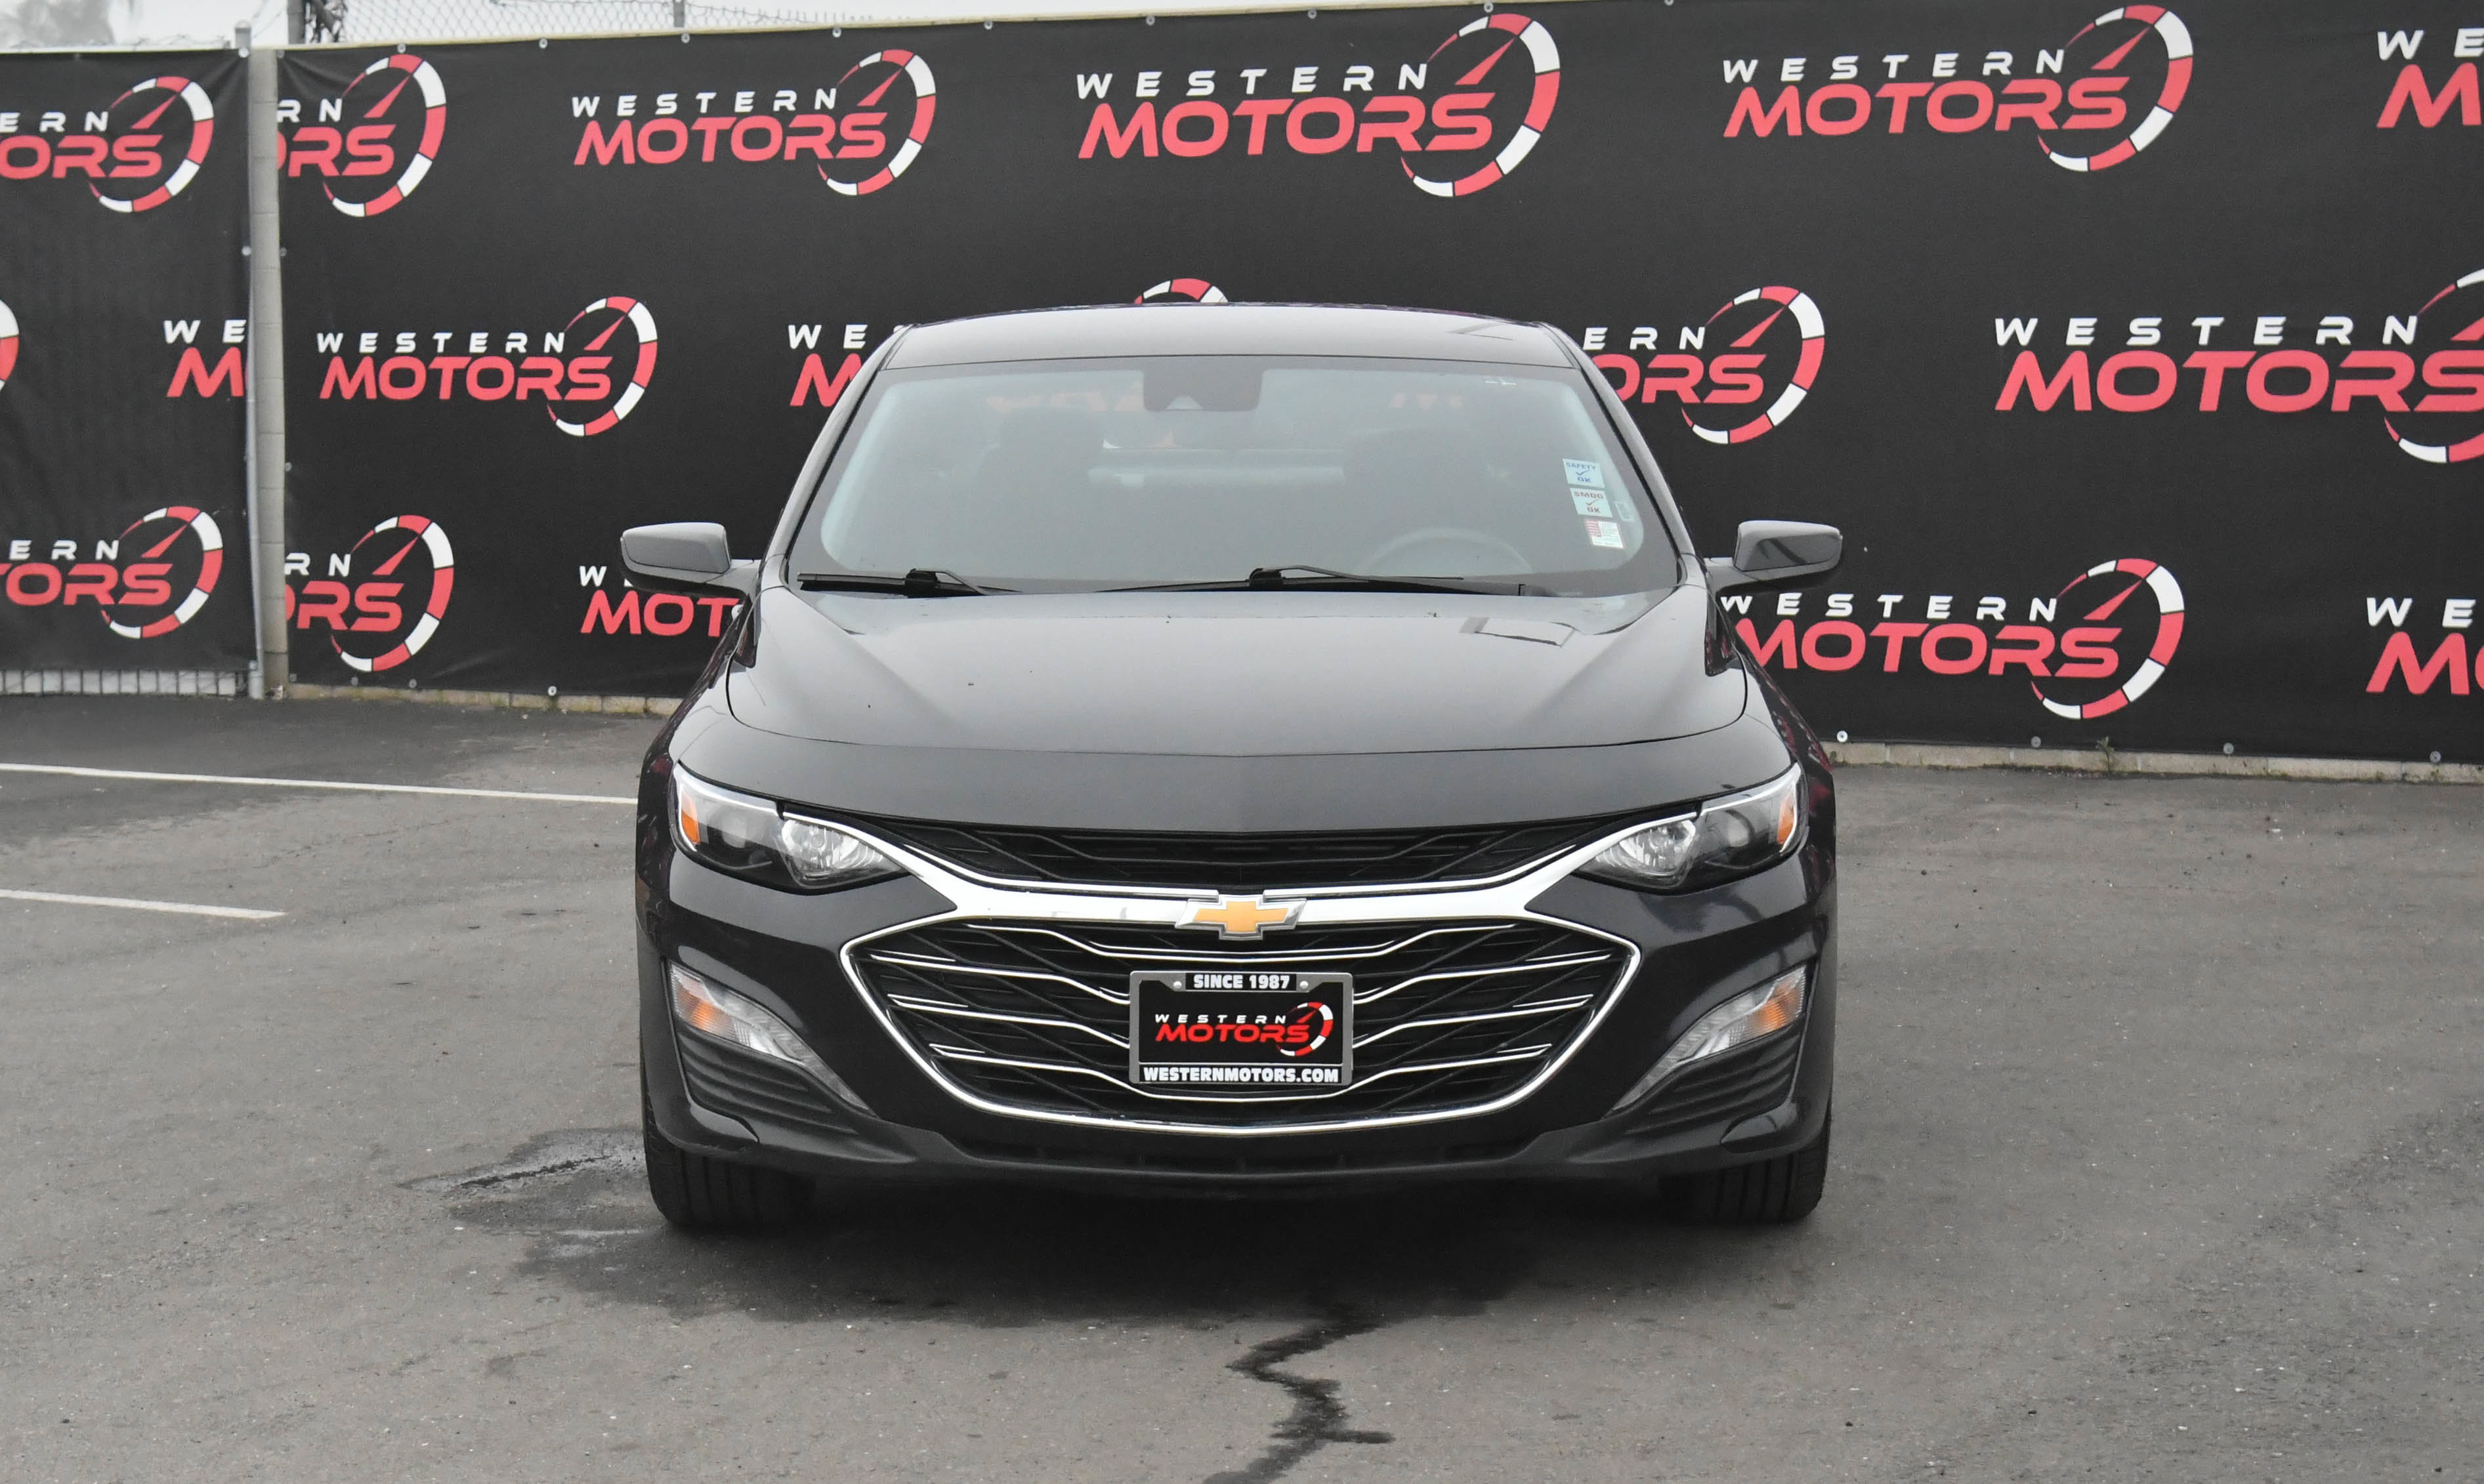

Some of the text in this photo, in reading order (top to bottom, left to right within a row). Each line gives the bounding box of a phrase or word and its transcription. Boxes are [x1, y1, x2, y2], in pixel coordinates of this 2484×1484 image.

[1076, 64, 1427, 99] WESTERN
[1723, 50, 2064, 83] WESTERN
[572, 89, 836, 117] WESTERN
[1724, 77, 2130, 138] MOTORS
[0, 112, 108, 133] ERN
[1078, 92, 1496, 159] MOTORS
[278, 124, 396, 177] RS
[574, 112, 887, 165] MOTORS
[318, 333, 564, 353] WESTERN
[788, 325, 904, 350] WE
[1995, 316, 2417, 346] WESTERN
[320, 356, 612, 401] MOTORS
[1995, 350, 2484, 413] MOTORS
[1721, 592, 2057, 621] WESTERN
[1735, 615, 2122, 678] MOTORS
[2366, 632, 2484, 695] M
[1194, 974, 1290, 990] SINCE 1987
[1155, 1023, 1311, 1043] MOTORS
[1156, 1014, 1286, 1023] WESTERN
[1143, 1067, 1339, 1083] WESTERNMOTORS.COM
